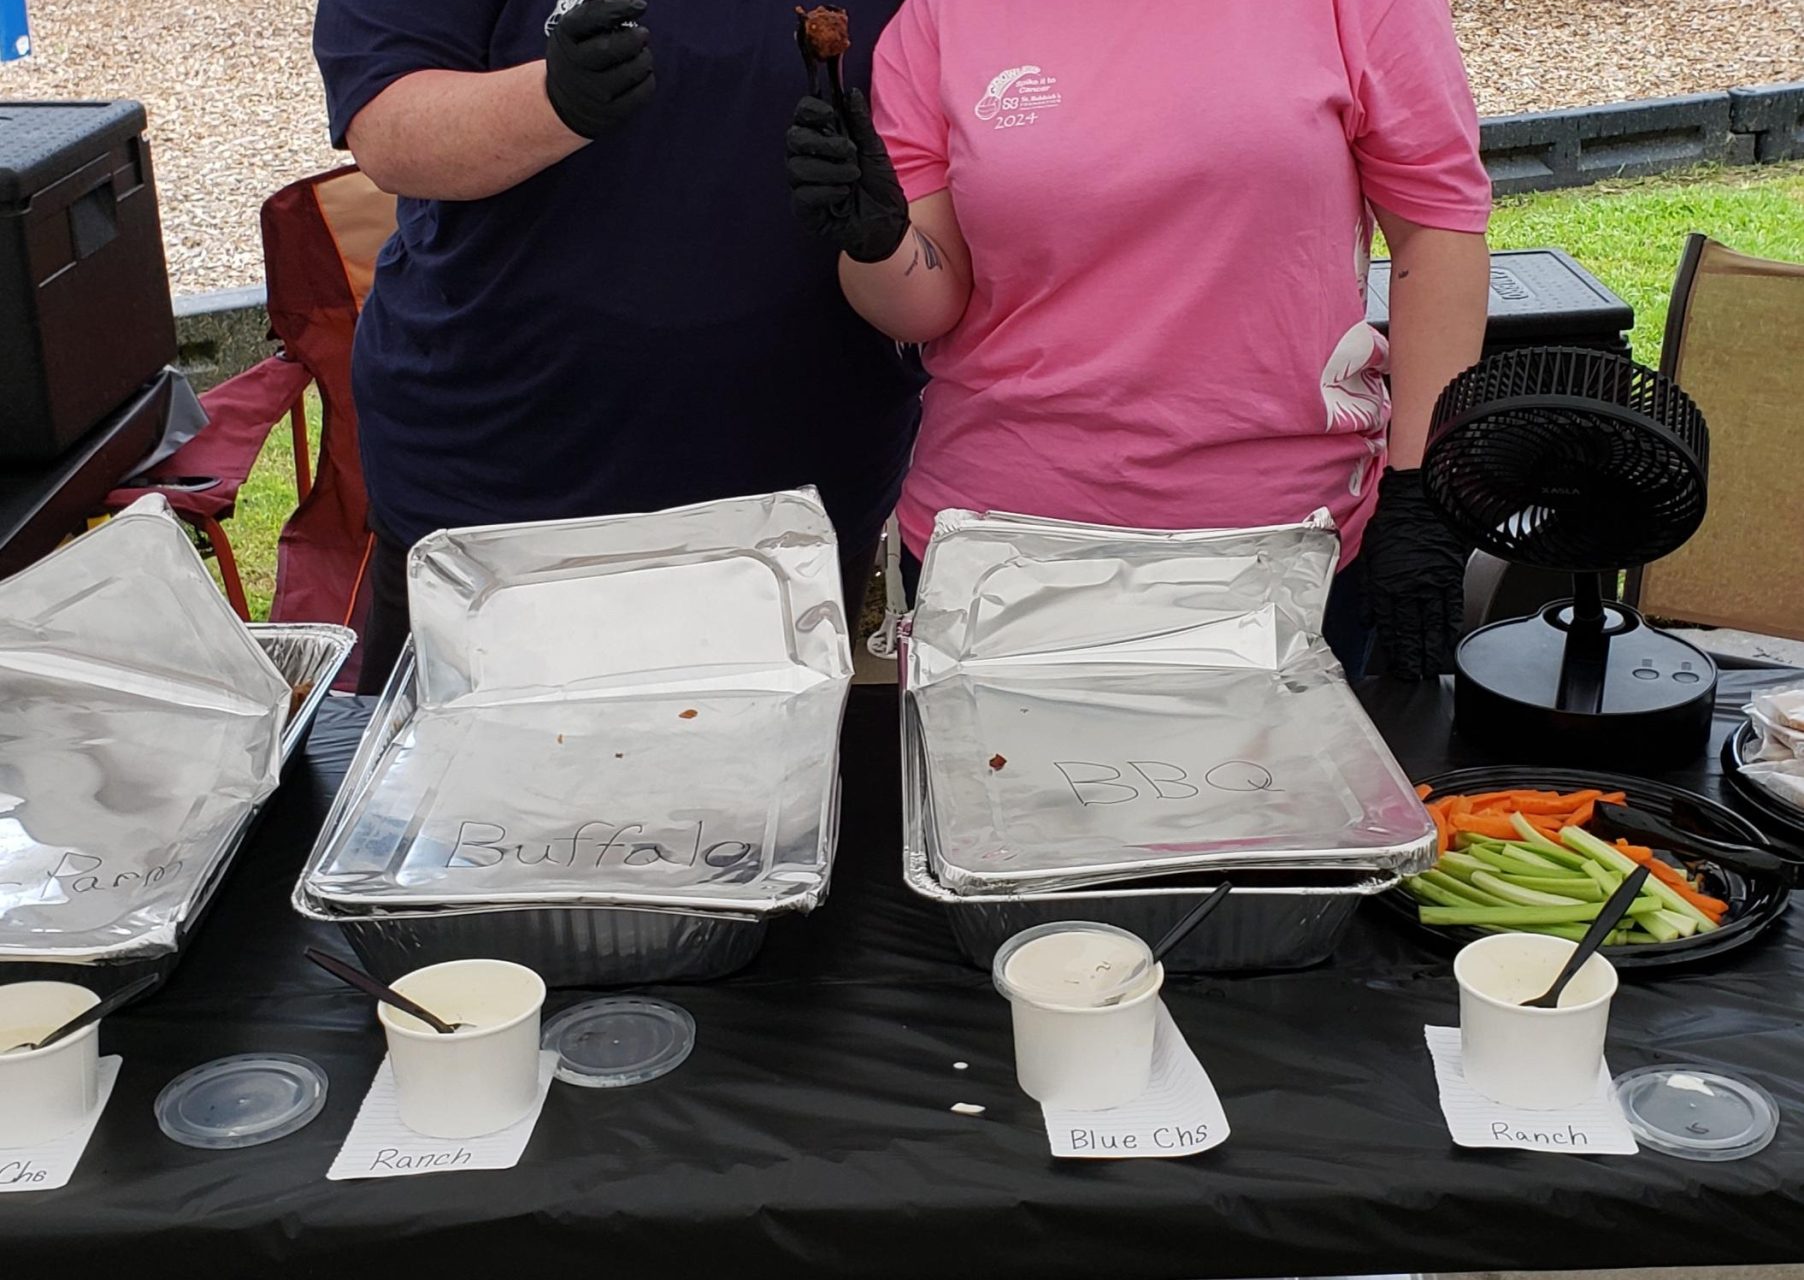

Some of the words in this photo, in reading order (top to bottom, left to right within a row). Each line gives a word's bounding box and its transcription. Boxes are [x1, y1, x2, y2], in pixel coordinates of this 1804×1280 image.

[1053, 760, 1285, 807] BBQ
[445, 820, 752, 869] Buffalo
[40, 851, 183, 900] Parm
[1070, 1128, 1138, 1150] Blue
[1153, 1123, 1208, 1149] Chs
[1490, 1122, 1589, 1146] Ranch
[368, 1147, 472, 1171] Ranch
